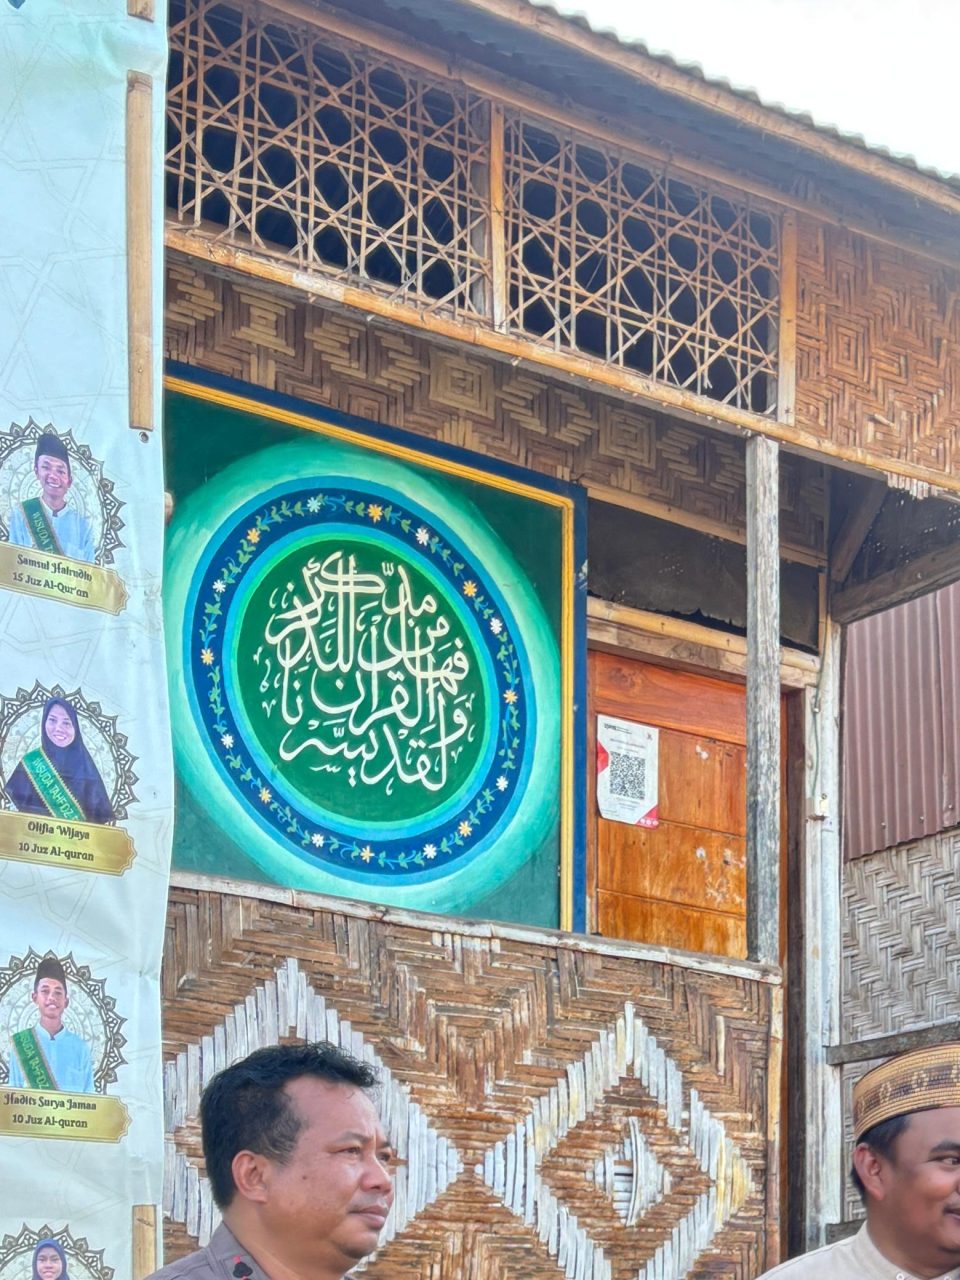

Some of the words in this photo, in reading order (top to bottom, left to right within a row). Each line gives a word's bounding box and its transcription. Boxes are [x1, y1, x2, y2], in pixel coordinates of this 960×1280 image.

[17, 554, 49, 571] Samsul
[12, 572, 23, 583] 15
[25, 575, 42, 587] Juz
[43, 581, 89, 598] Al-Qur'an
[56, 825, 90, 840] Wijaya
[18, 843, 30, 852] 10
[31, 844, 48, 854] Juz
[50, 846, 94, 861] Al-quran
[38, 1096, 65, 1110] Surya
[12, 1114, 23, 1123] 10
[25, 1115, 42, 1125] Juz
[44, 1116, 88, 1128] Al-quran
